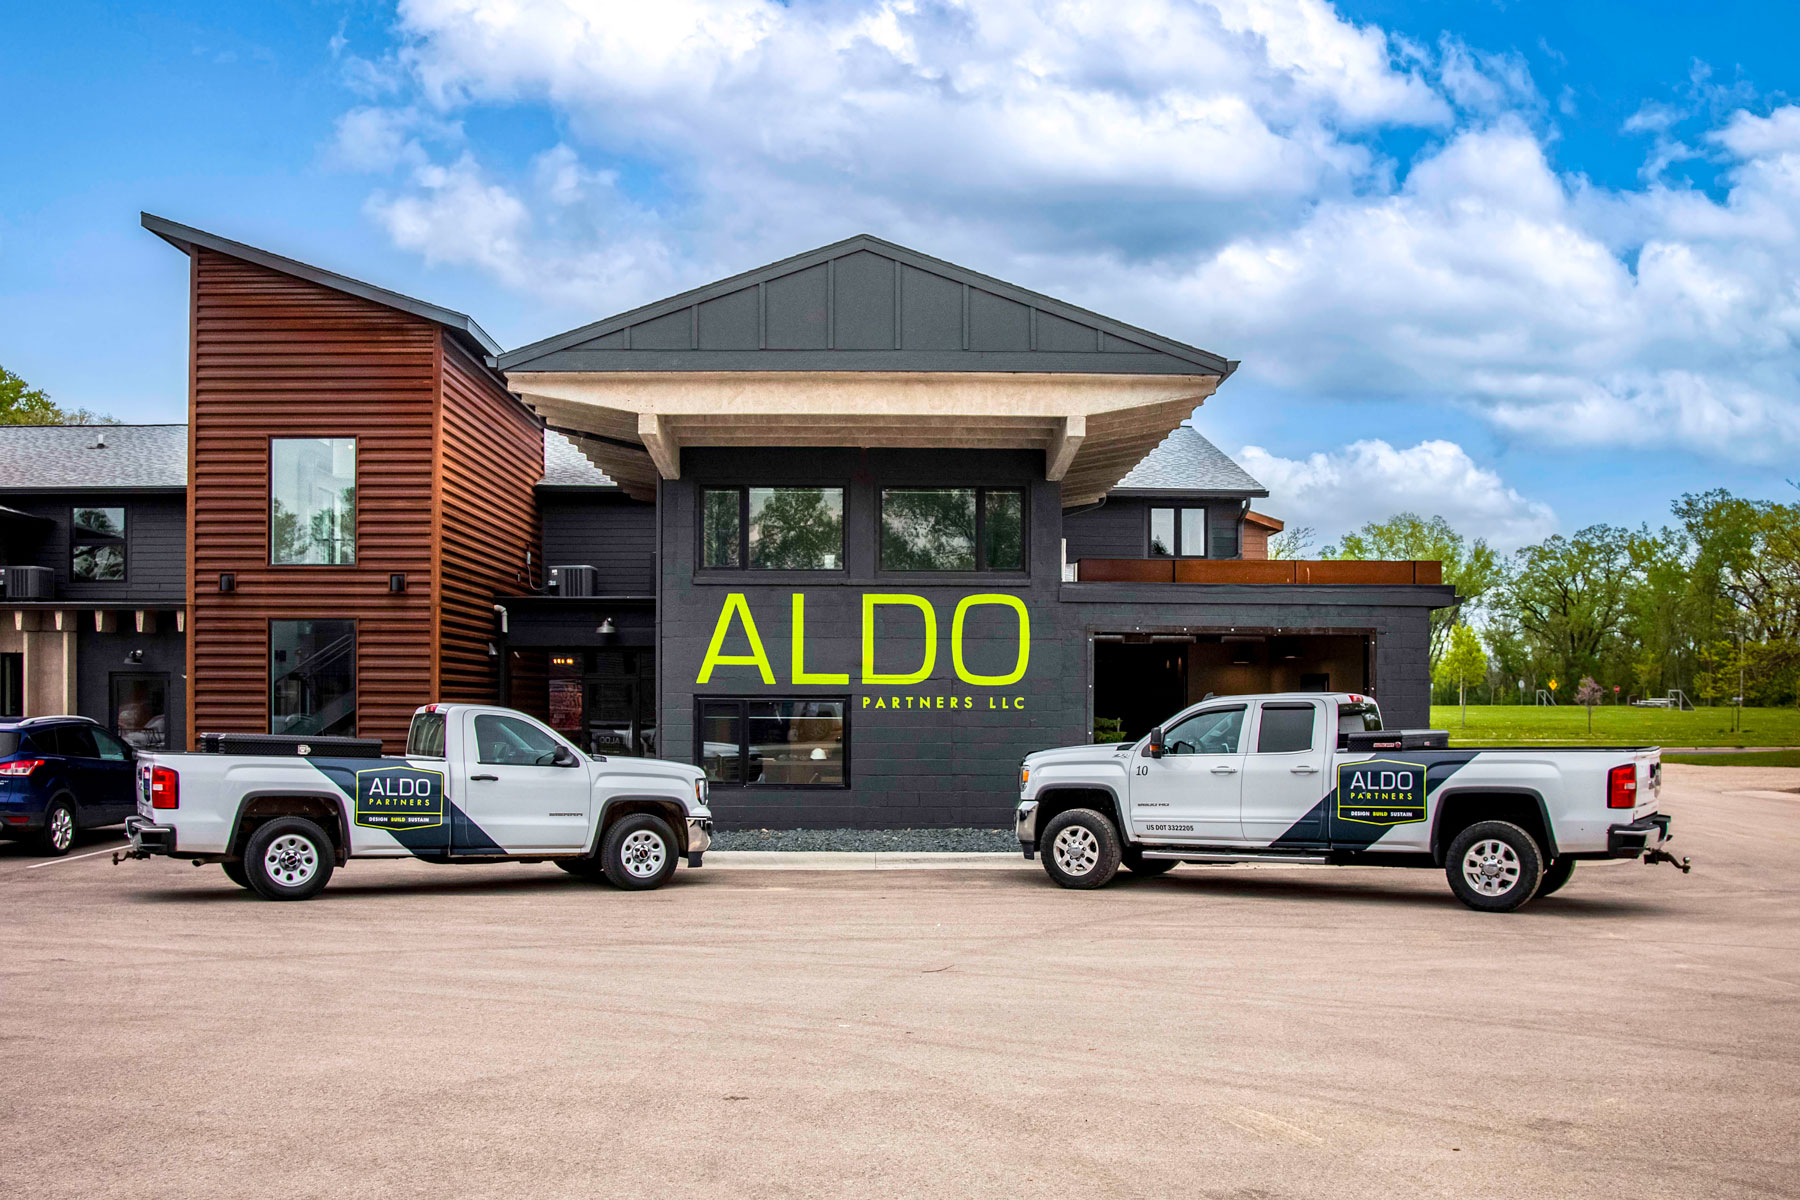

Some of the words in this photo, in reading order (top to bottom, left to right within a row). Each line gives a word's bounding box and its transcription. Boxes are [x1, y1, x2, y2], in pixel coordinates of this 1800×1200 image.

[696, 593, 1030, 686] ALDO
[862, 696, 973, 709] PARTNERS
[989, 696, 1025, 709] LLC
[1136, 765, 1149, 776] 10
[369, 777, 431, 796] ALDO
[1350, 771, 1413, 790] ALDO
[369, 798, 430, 806] PARTNERS
[1350, 792, 1413, 800] PARTNERS
[1168, 824, 1194, 832] 3322205
